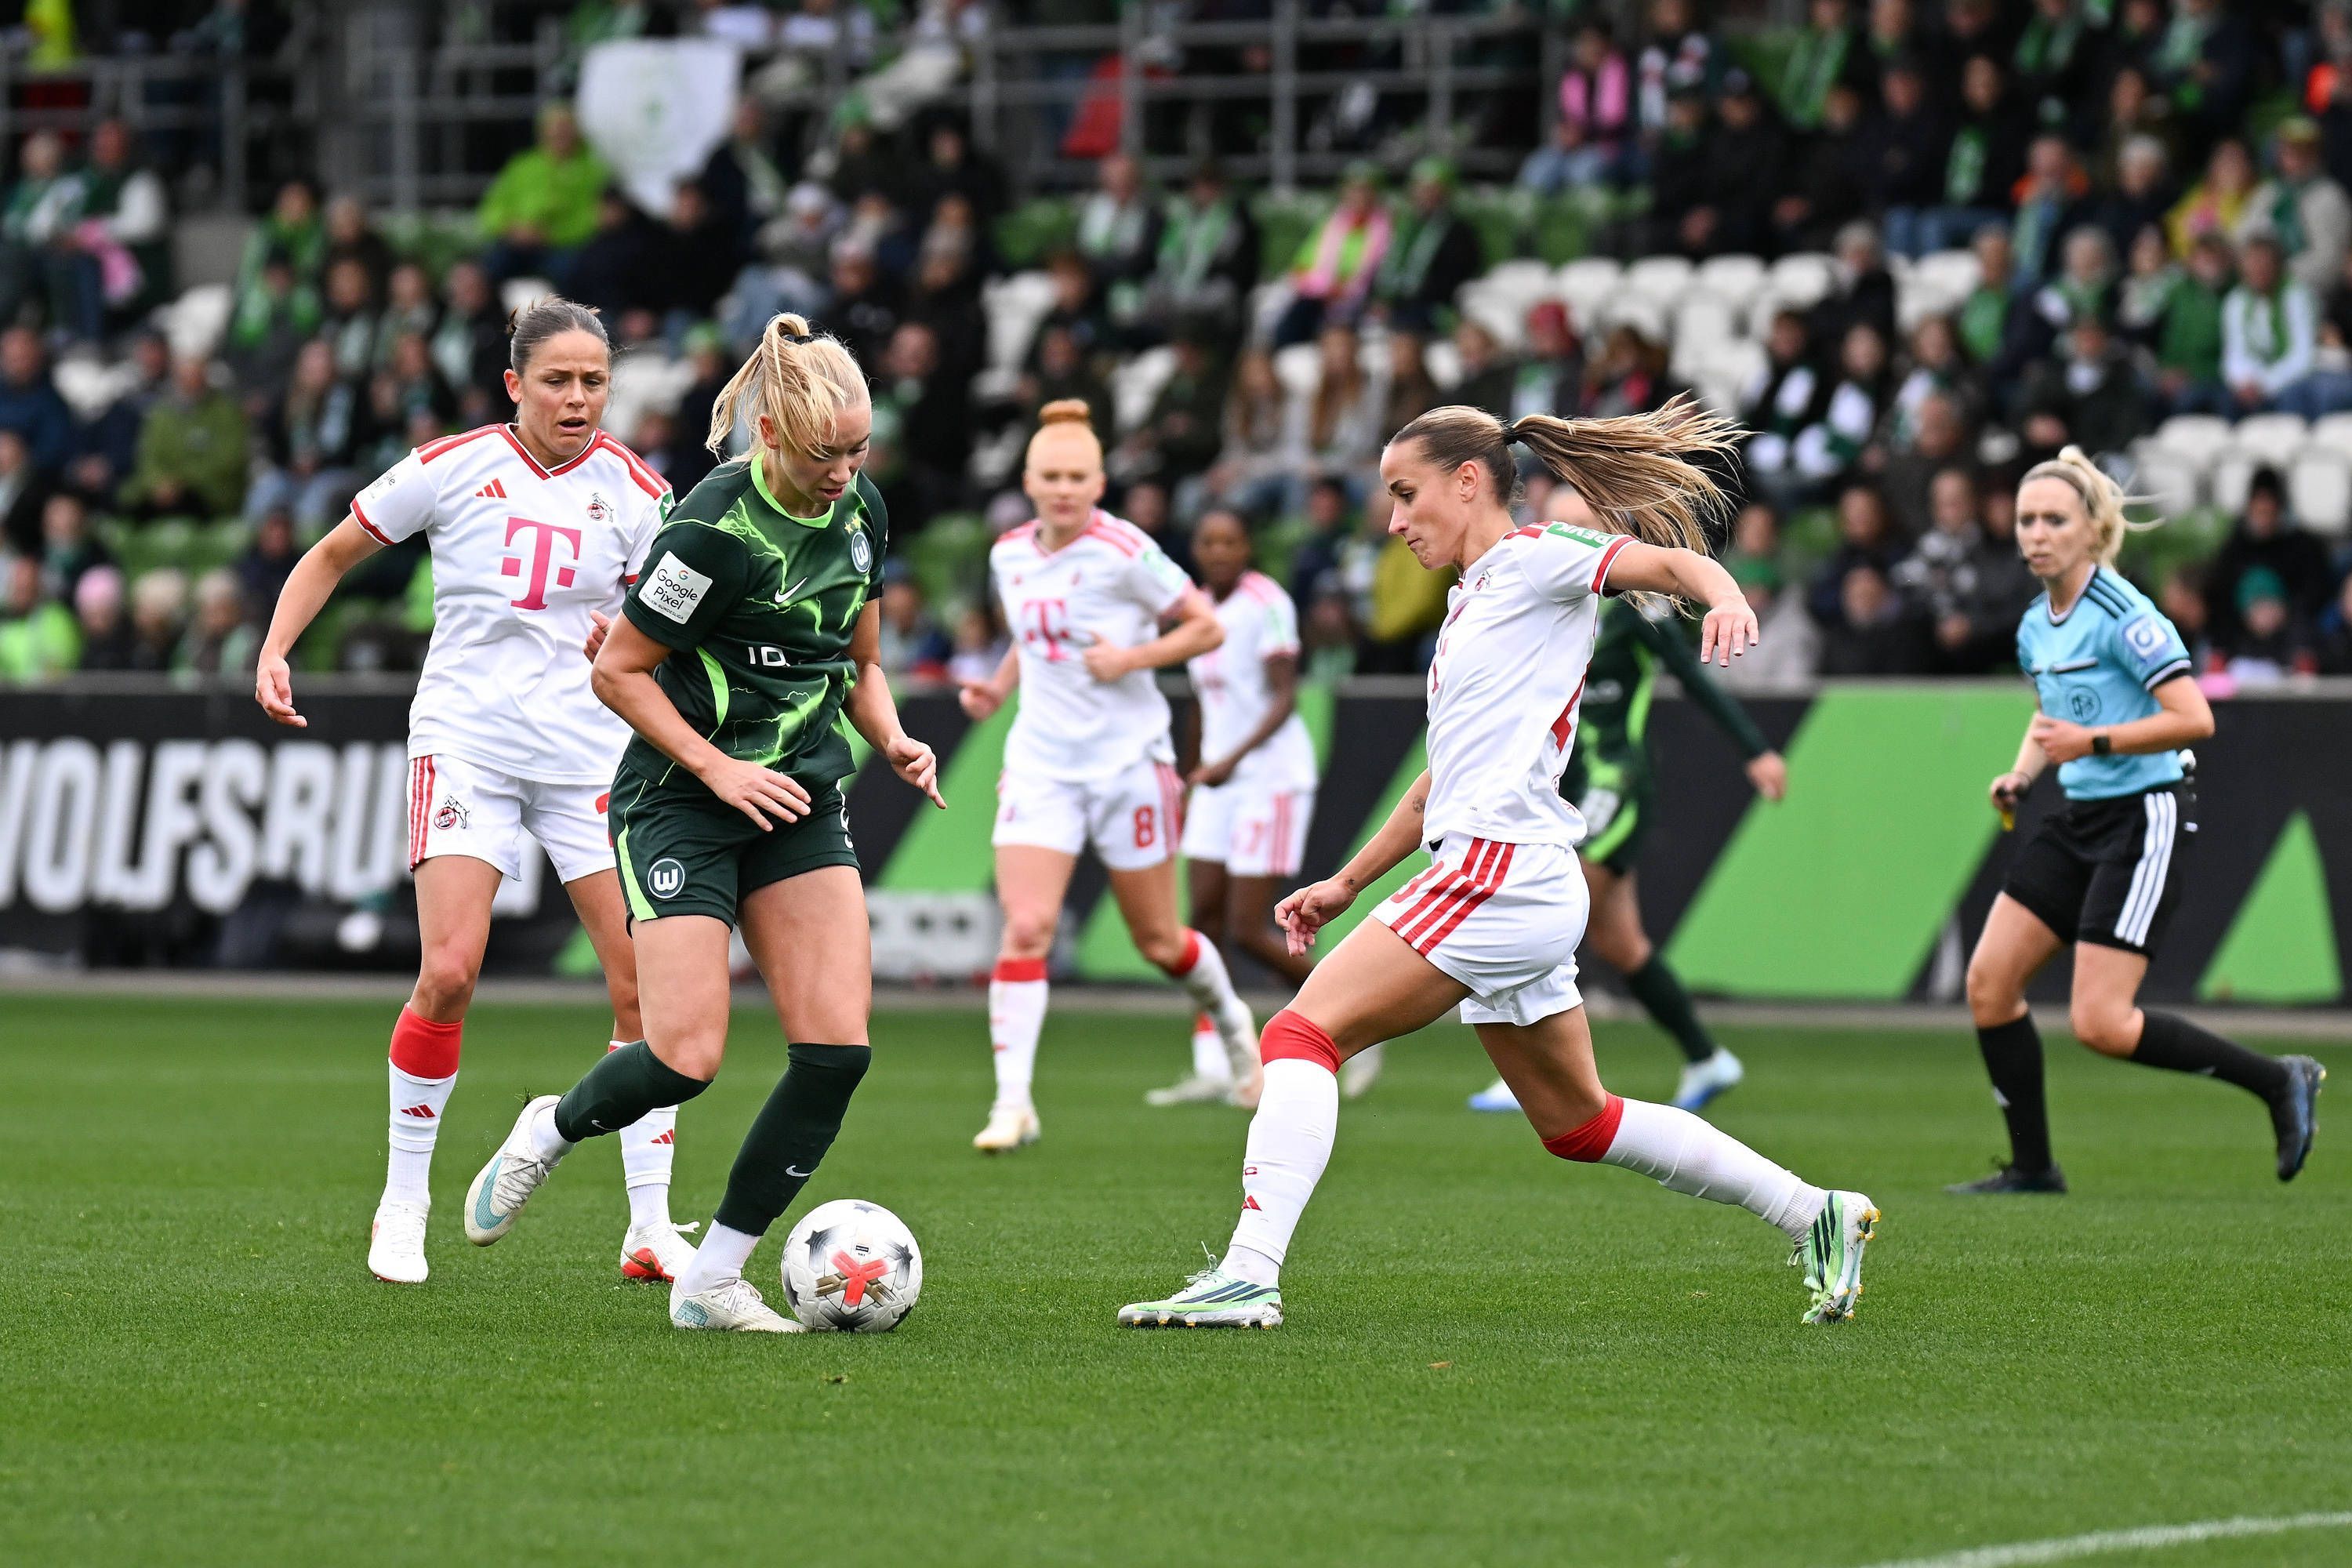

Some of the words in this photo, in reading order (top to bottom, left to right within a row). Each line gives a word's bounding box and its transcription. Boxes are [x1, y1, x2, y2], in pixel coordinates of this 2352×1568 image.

[653, 586, 684, 610] Pixel
[657, 568, 698, 601] Google
[1134, 805, 1155, 848] 8
